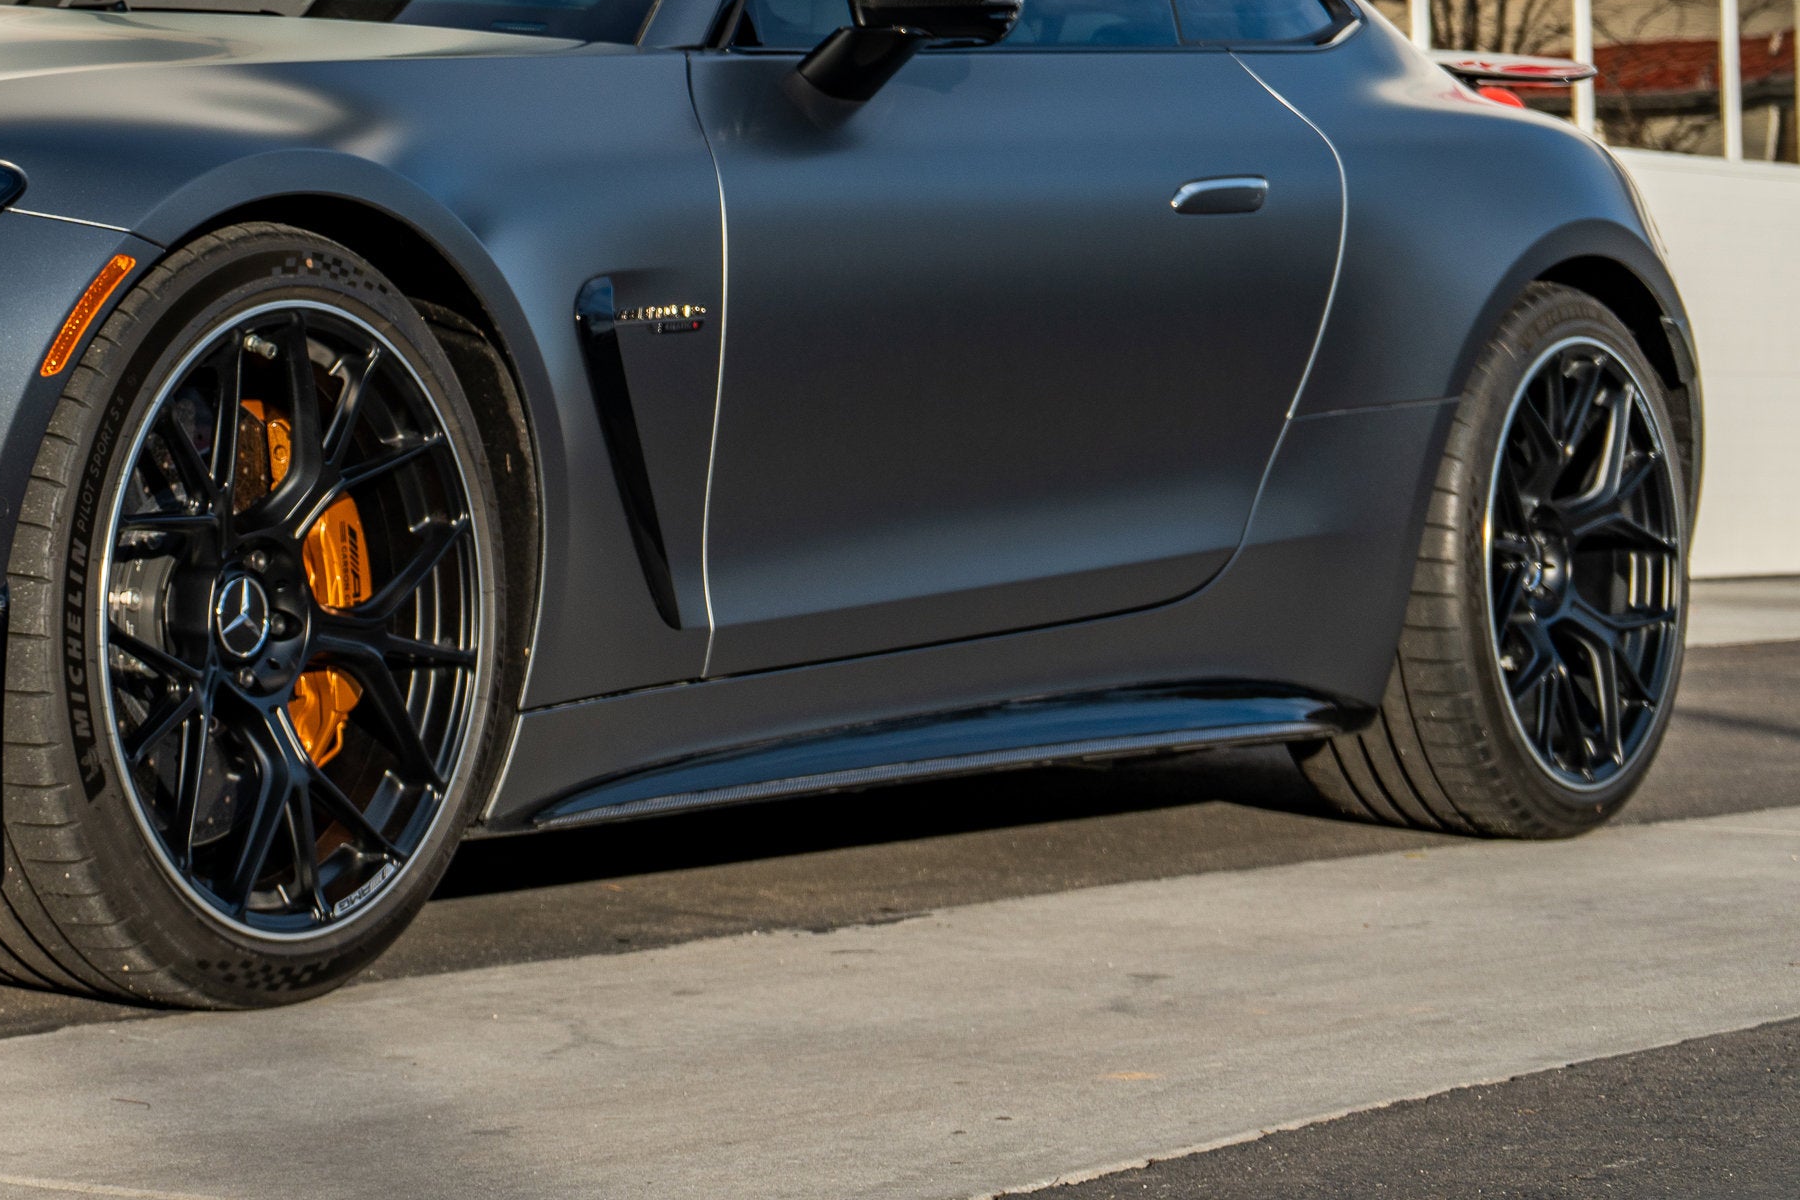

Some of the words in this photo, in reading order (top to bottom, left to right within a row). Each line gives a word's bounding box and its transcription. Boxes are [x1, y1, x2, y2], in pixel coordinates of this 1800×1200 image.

[89, 422, 115, 479] SPORT
[76, 480, 96, 533] PILOT
[66, 537, 92, 738] MICHELIN
